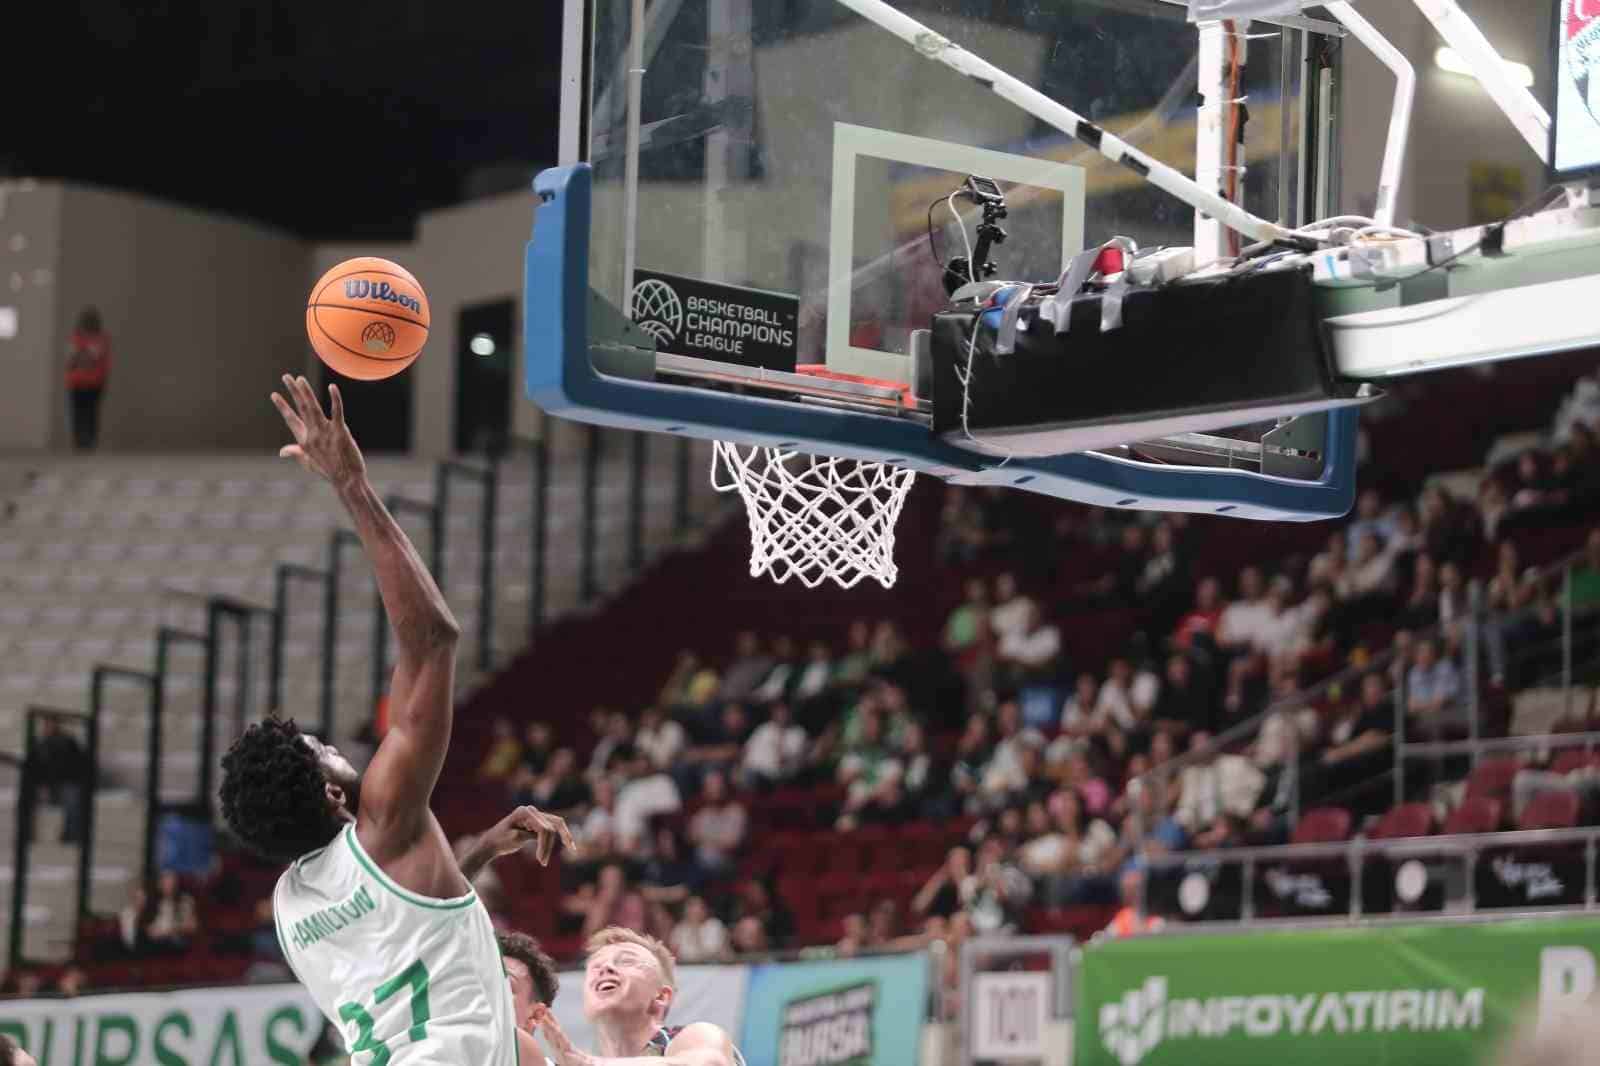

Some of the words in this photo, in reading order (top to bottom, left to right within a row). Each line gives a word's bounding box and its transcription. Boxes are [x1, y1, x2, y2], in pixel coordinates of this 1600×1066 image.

[345, 279, 421, 314] Wilson
[687, 296, 782, 326] BASKETBALL
[685, 331, 744, 354] LEAGUE
[686, 313, 793, 347] CHAMPIONS
[290, 885, 376, 950] HAMILTON
[338, 958, 431, 1066] 37
[1167, 987, 1485, 1039] INFOYATIRIM
